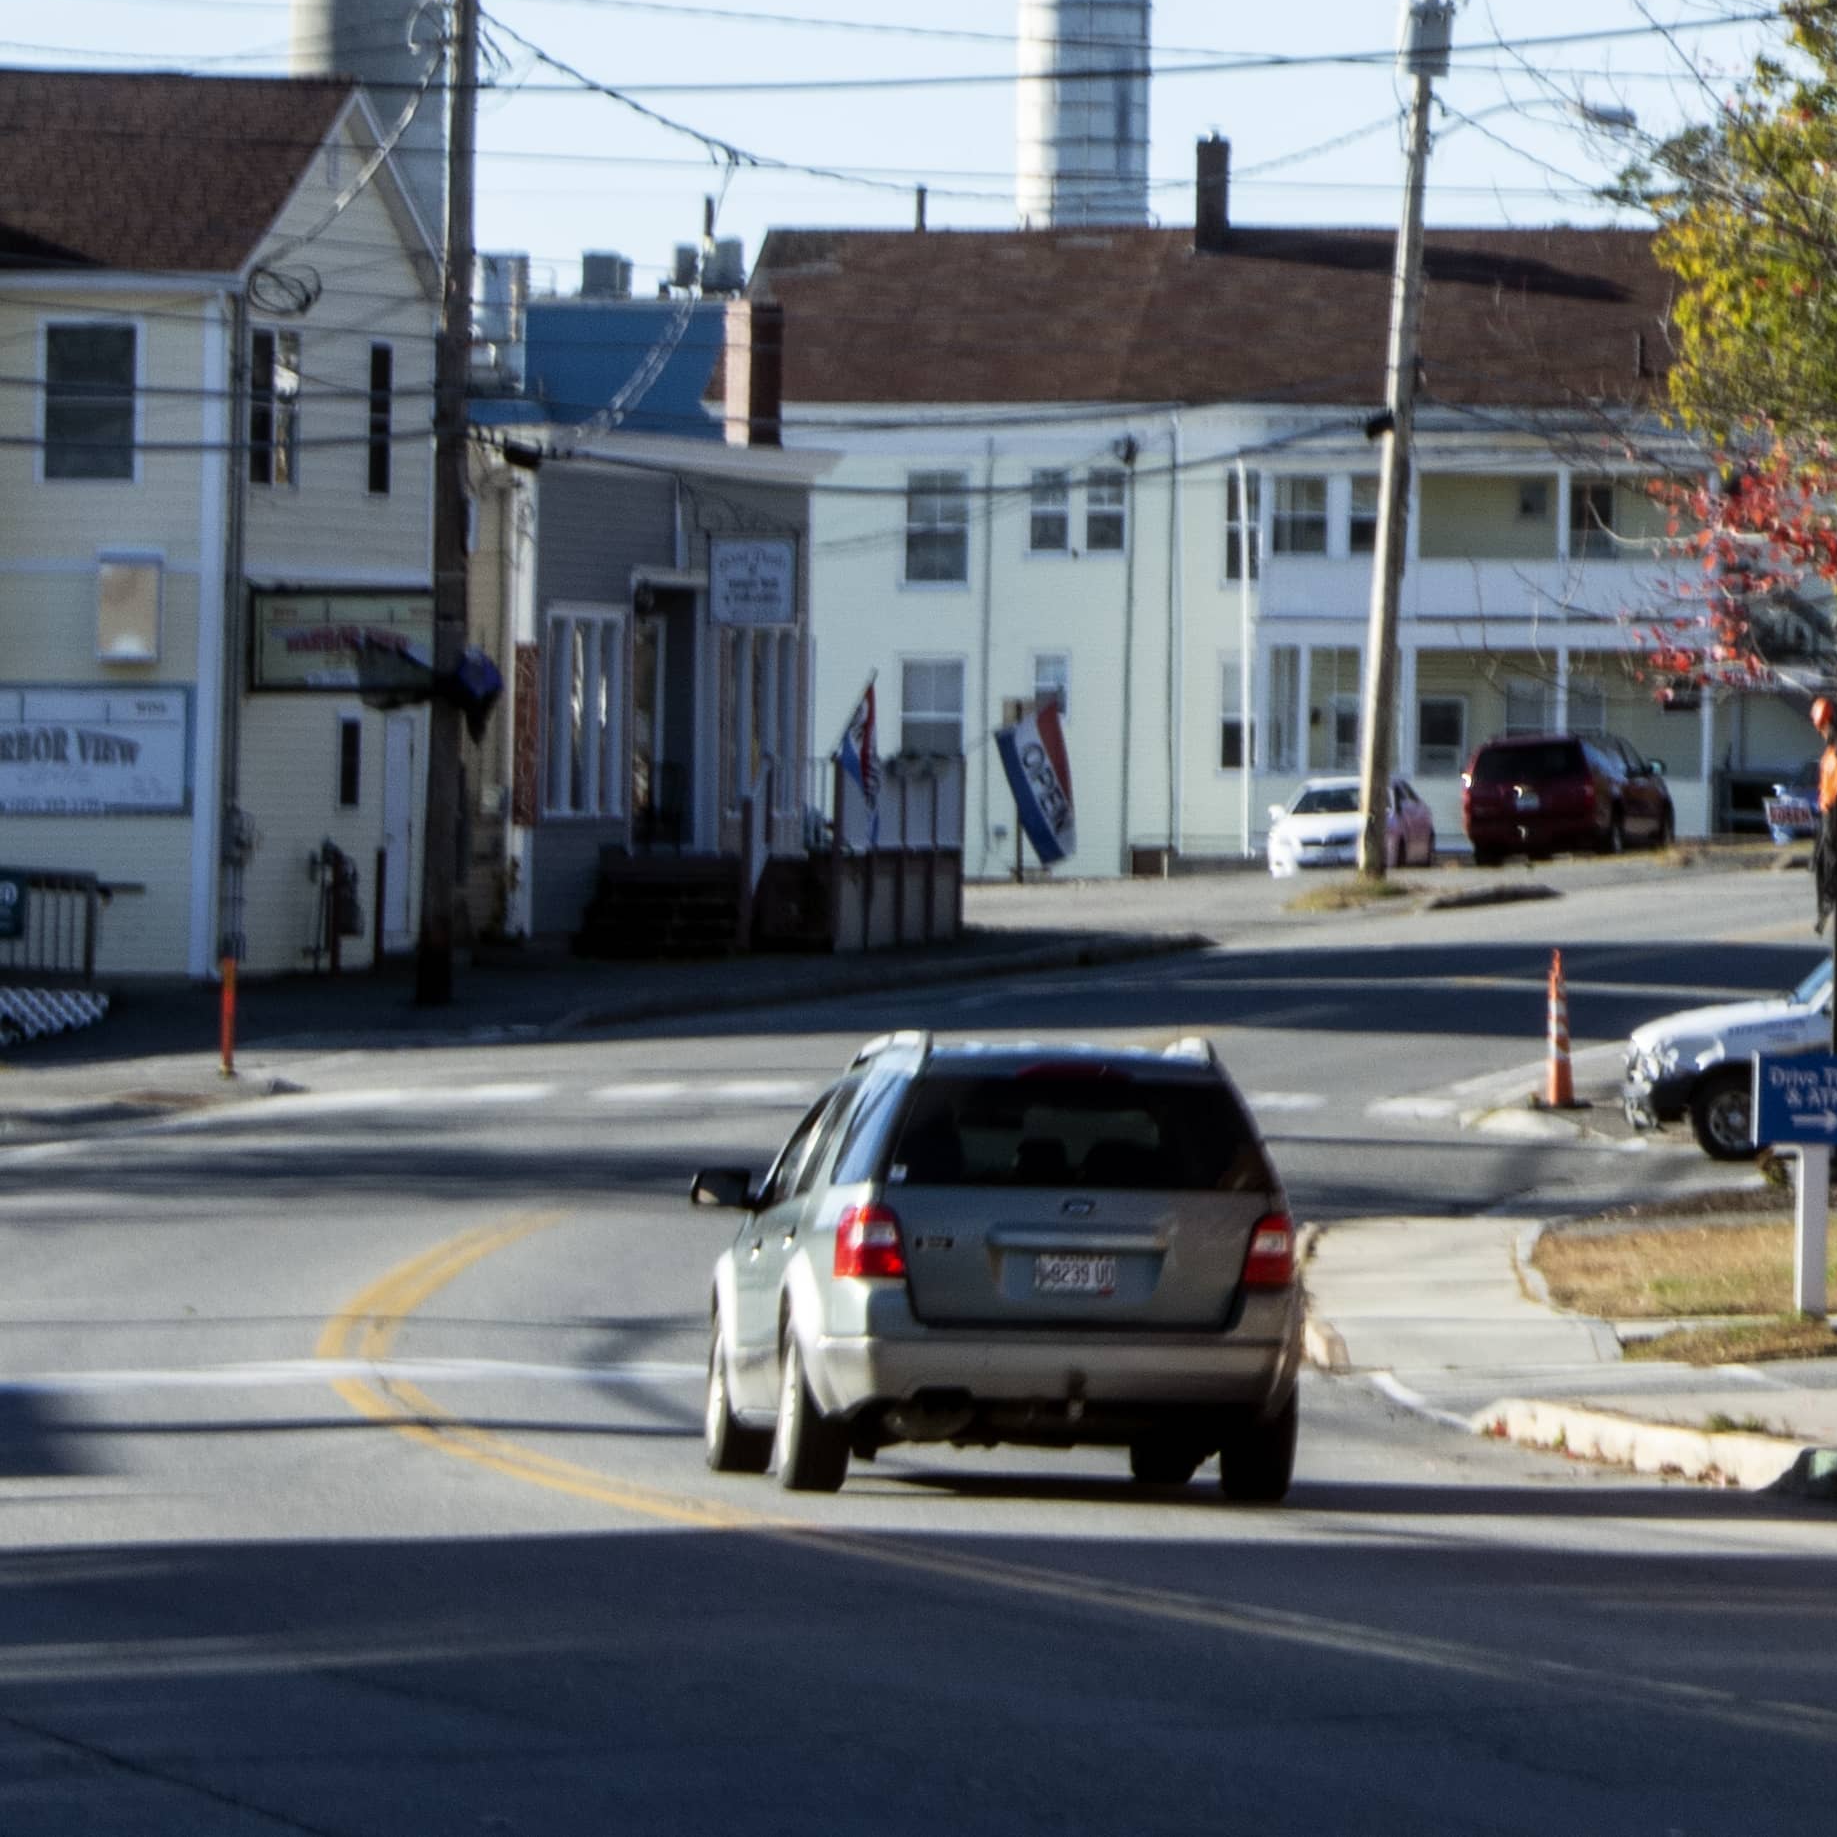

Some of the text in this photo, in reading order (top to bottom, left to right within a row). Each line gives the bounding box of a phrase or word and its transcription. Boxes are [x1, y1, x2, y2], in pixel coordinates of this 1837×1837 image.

[76, 727, 142, 767] VIEW
[1768, 1065, 1820, 1087] Drive
[1785, 1087, 1801, 1106] &
